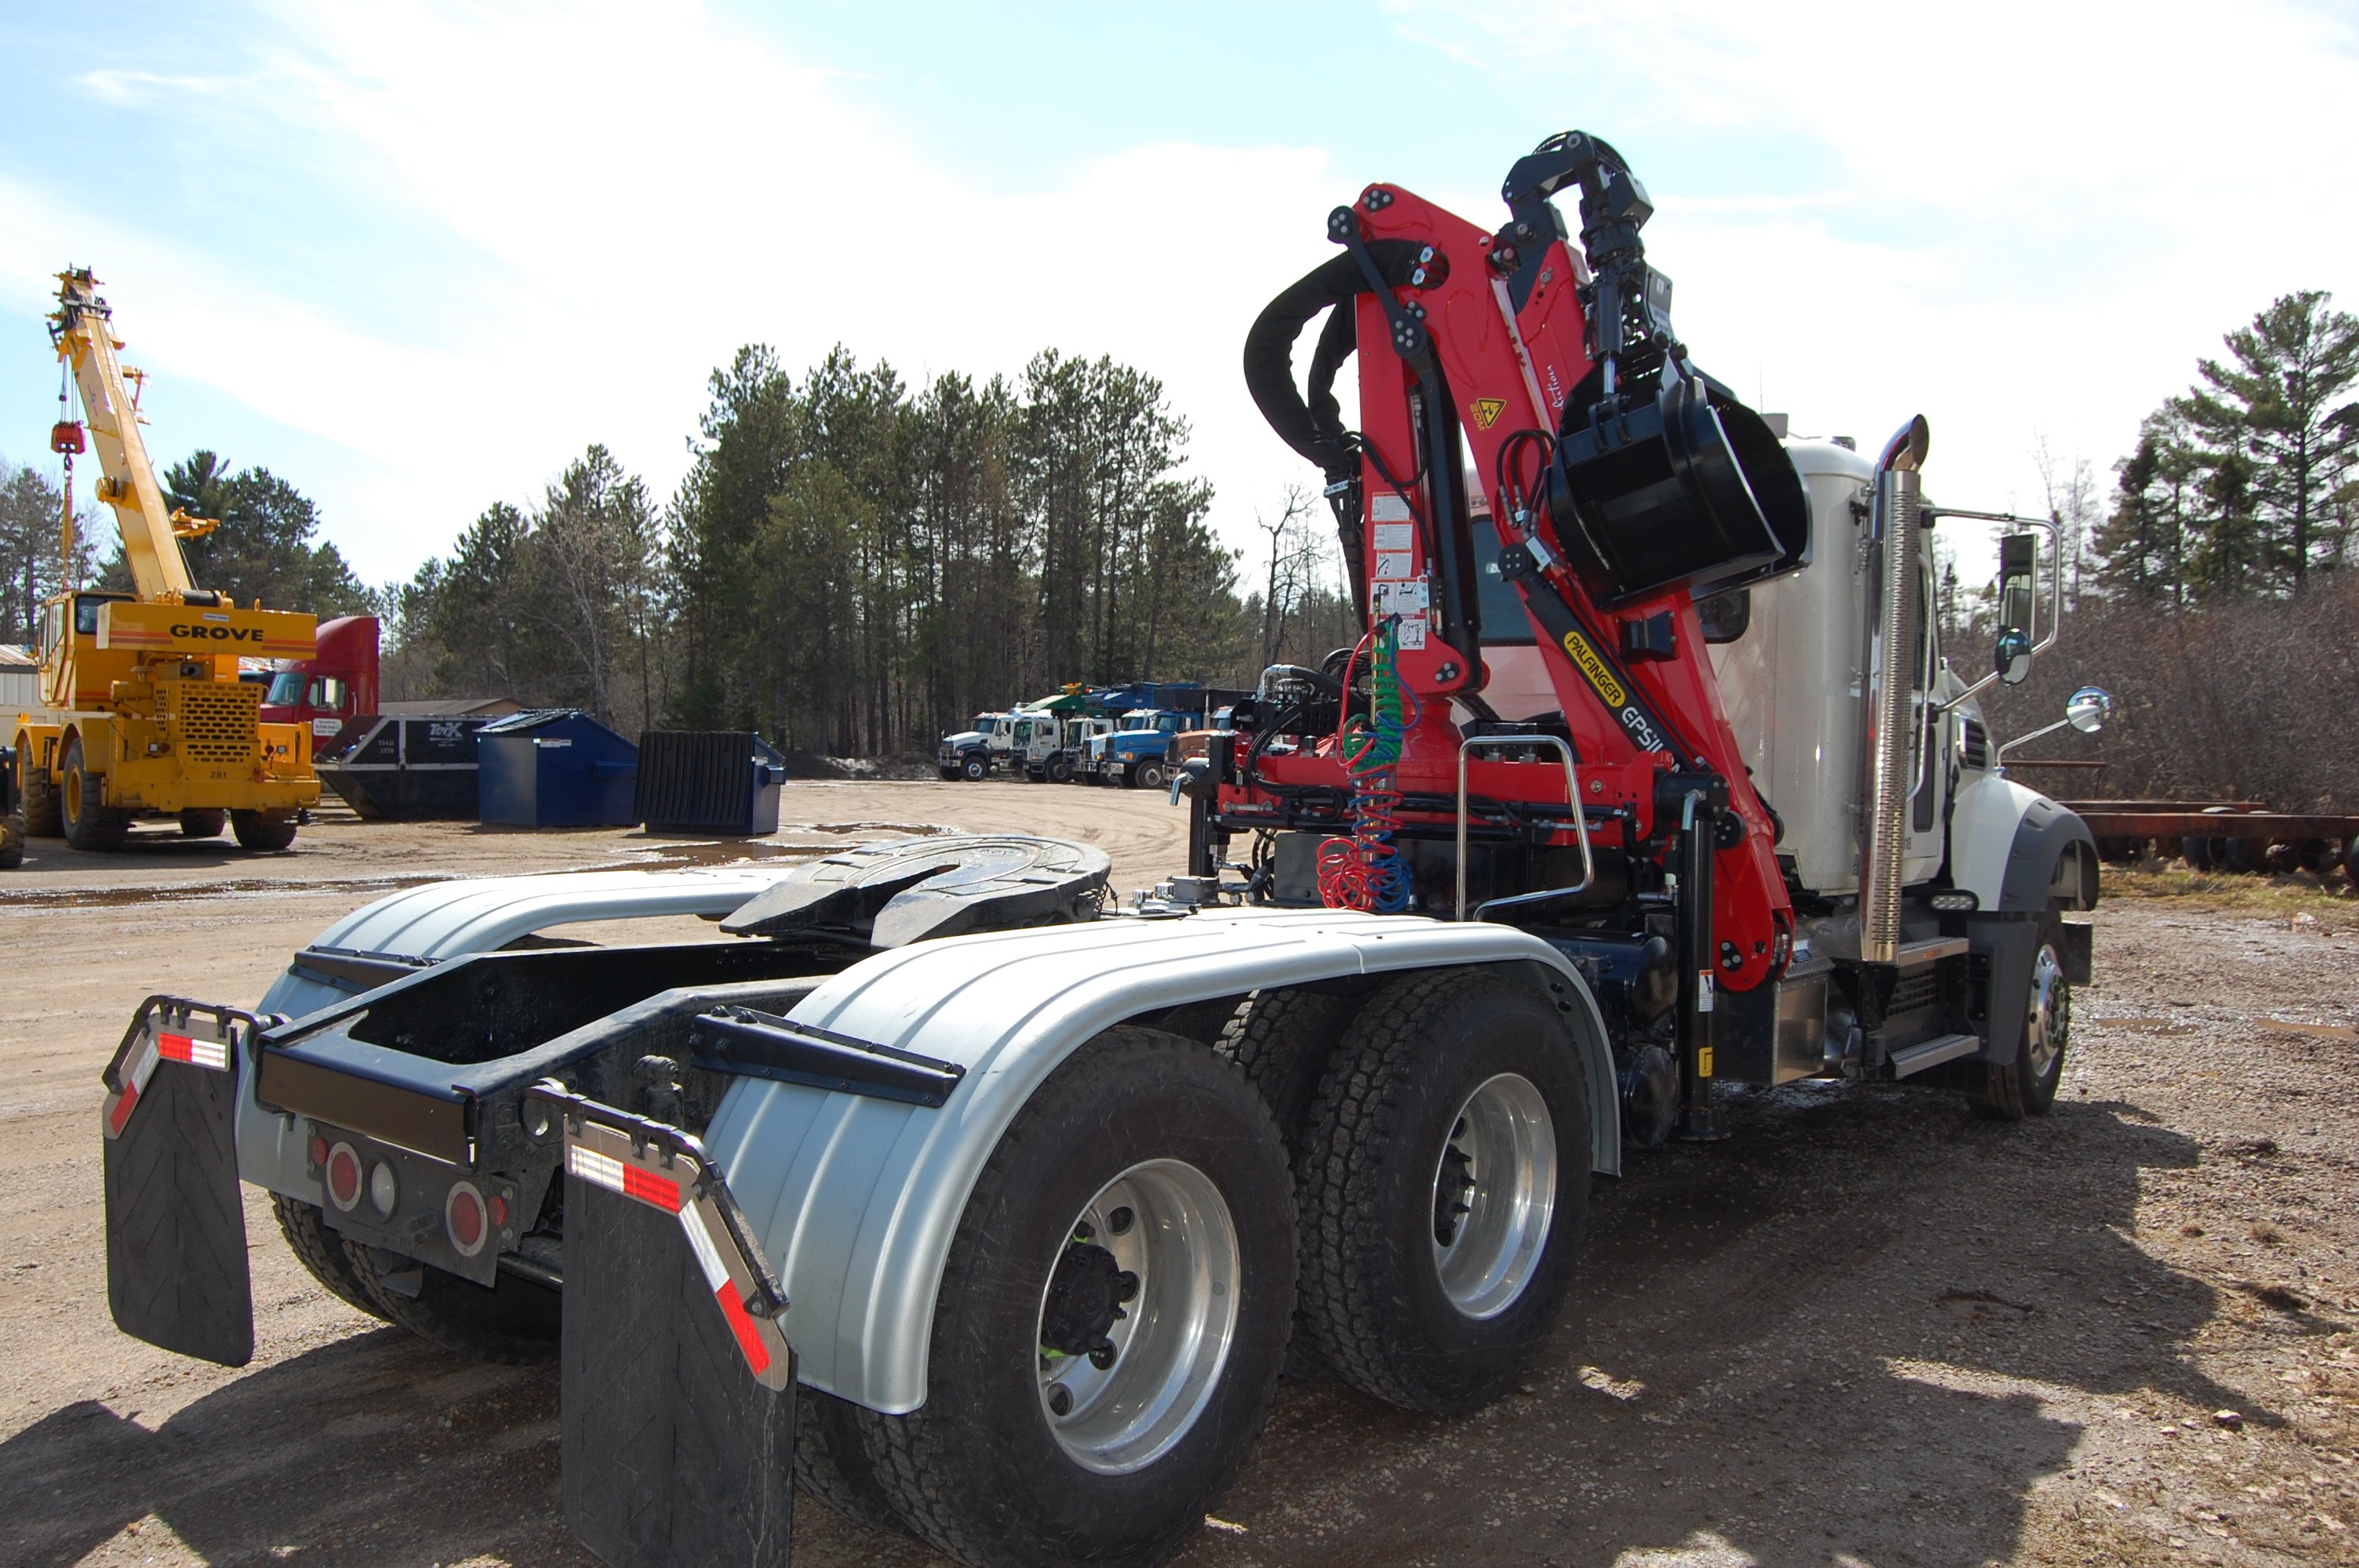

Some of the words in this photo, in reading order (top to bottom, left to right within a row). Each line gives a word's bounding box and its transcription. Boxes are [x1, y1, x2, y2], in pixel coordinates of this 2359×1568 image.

[1470, 403, 1485, 431] 20M
[169, 624, 264, 642] GROVE
[1568, 635, 1622, 703] PALFINGER
[1622, 706, 1681, 773] EPSIL
